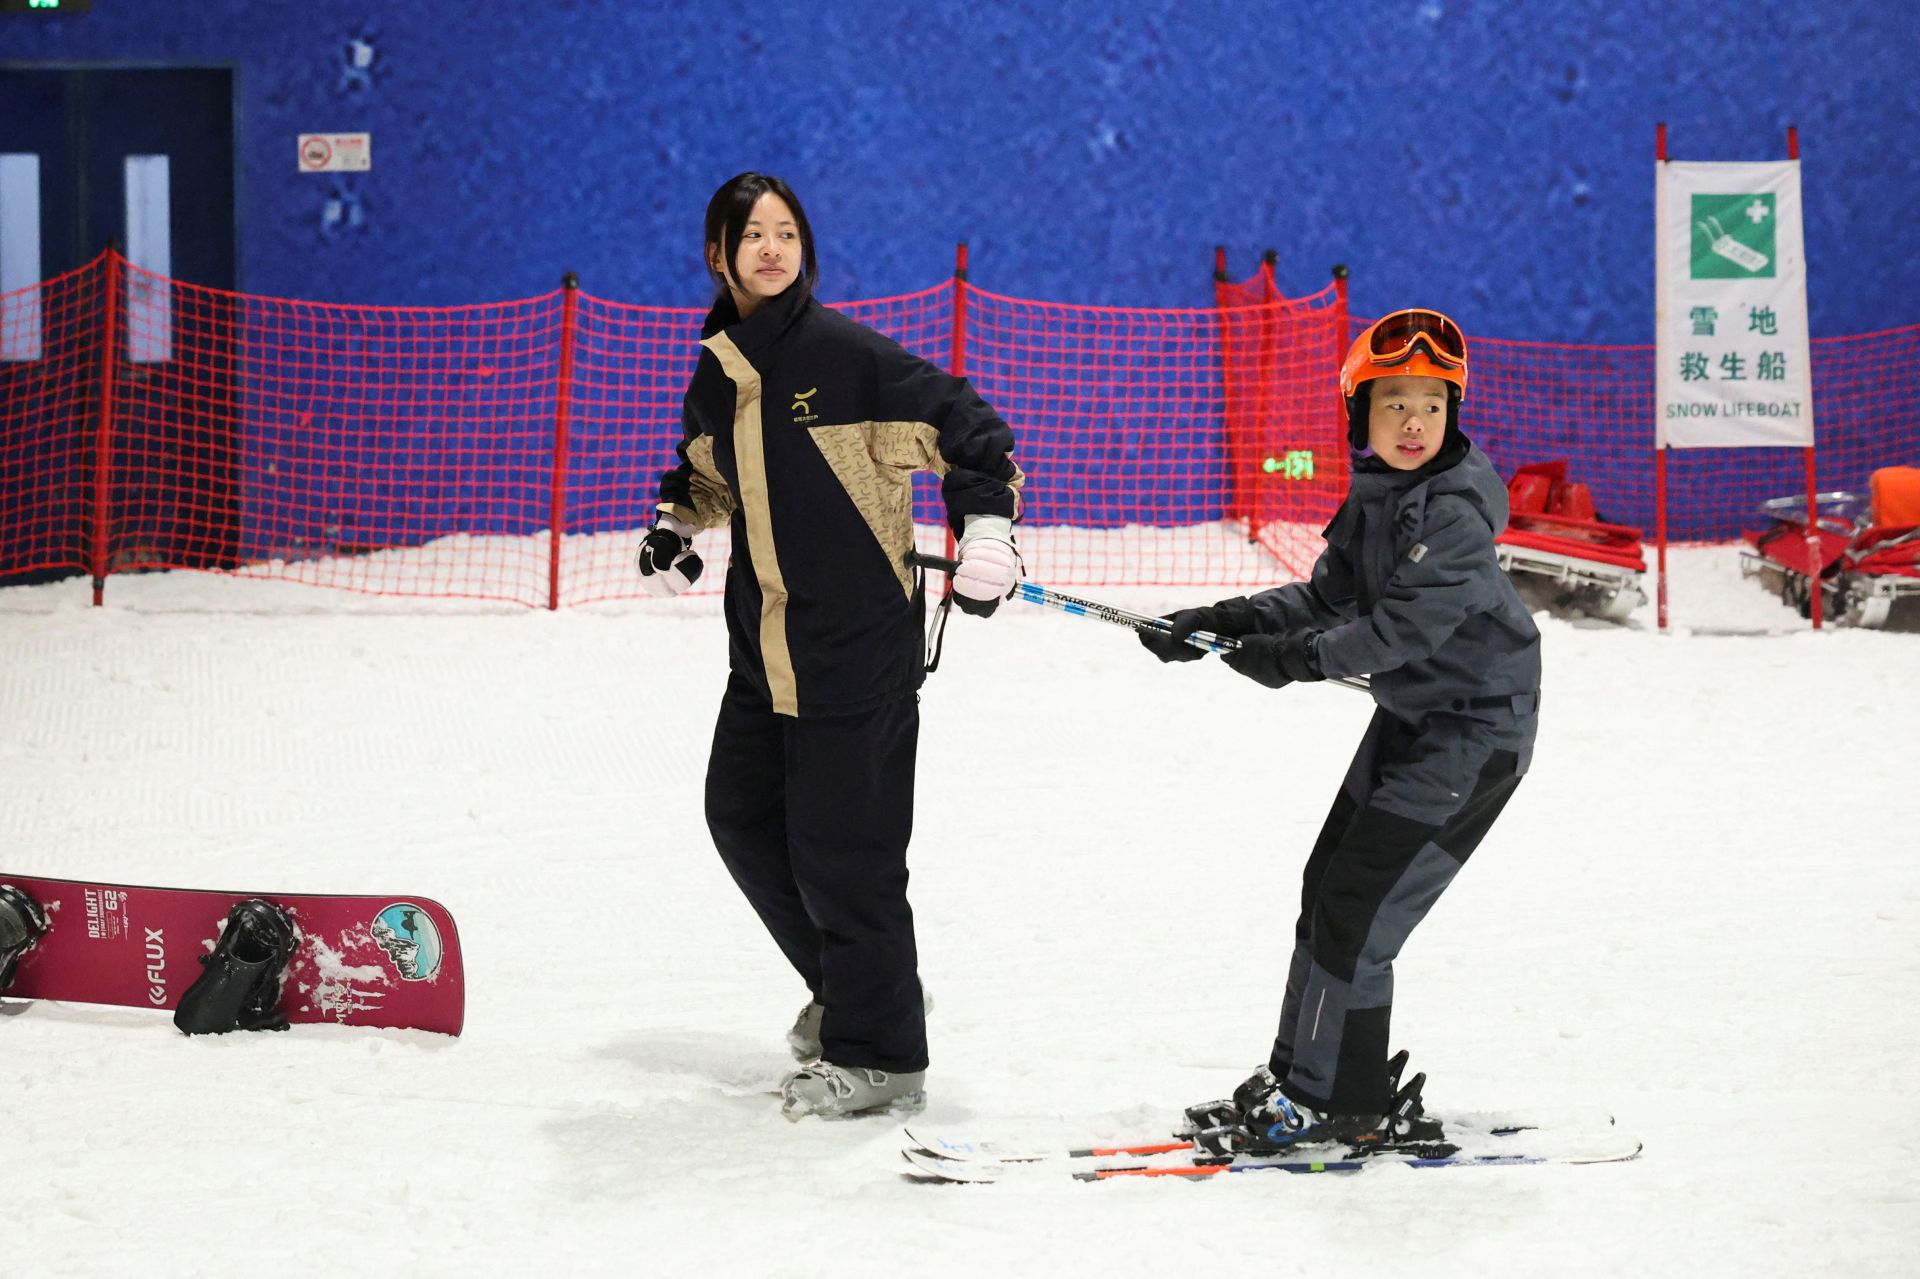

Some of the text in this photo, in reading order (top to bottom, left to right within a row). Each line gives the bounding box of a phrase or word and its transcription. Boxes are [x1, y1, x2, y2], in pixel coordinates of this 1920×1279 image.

[1690, 305, 1778, 336] 雪地
[1680, 350, 1786, 381] 救生船
[1666, 402, 1801, 418] SNOW LIFEBOAT
[85, 888, 100, 938] DELIGHT
[104, 890, 118, 911] 62
[144, 926, 166, 984] FLUX
